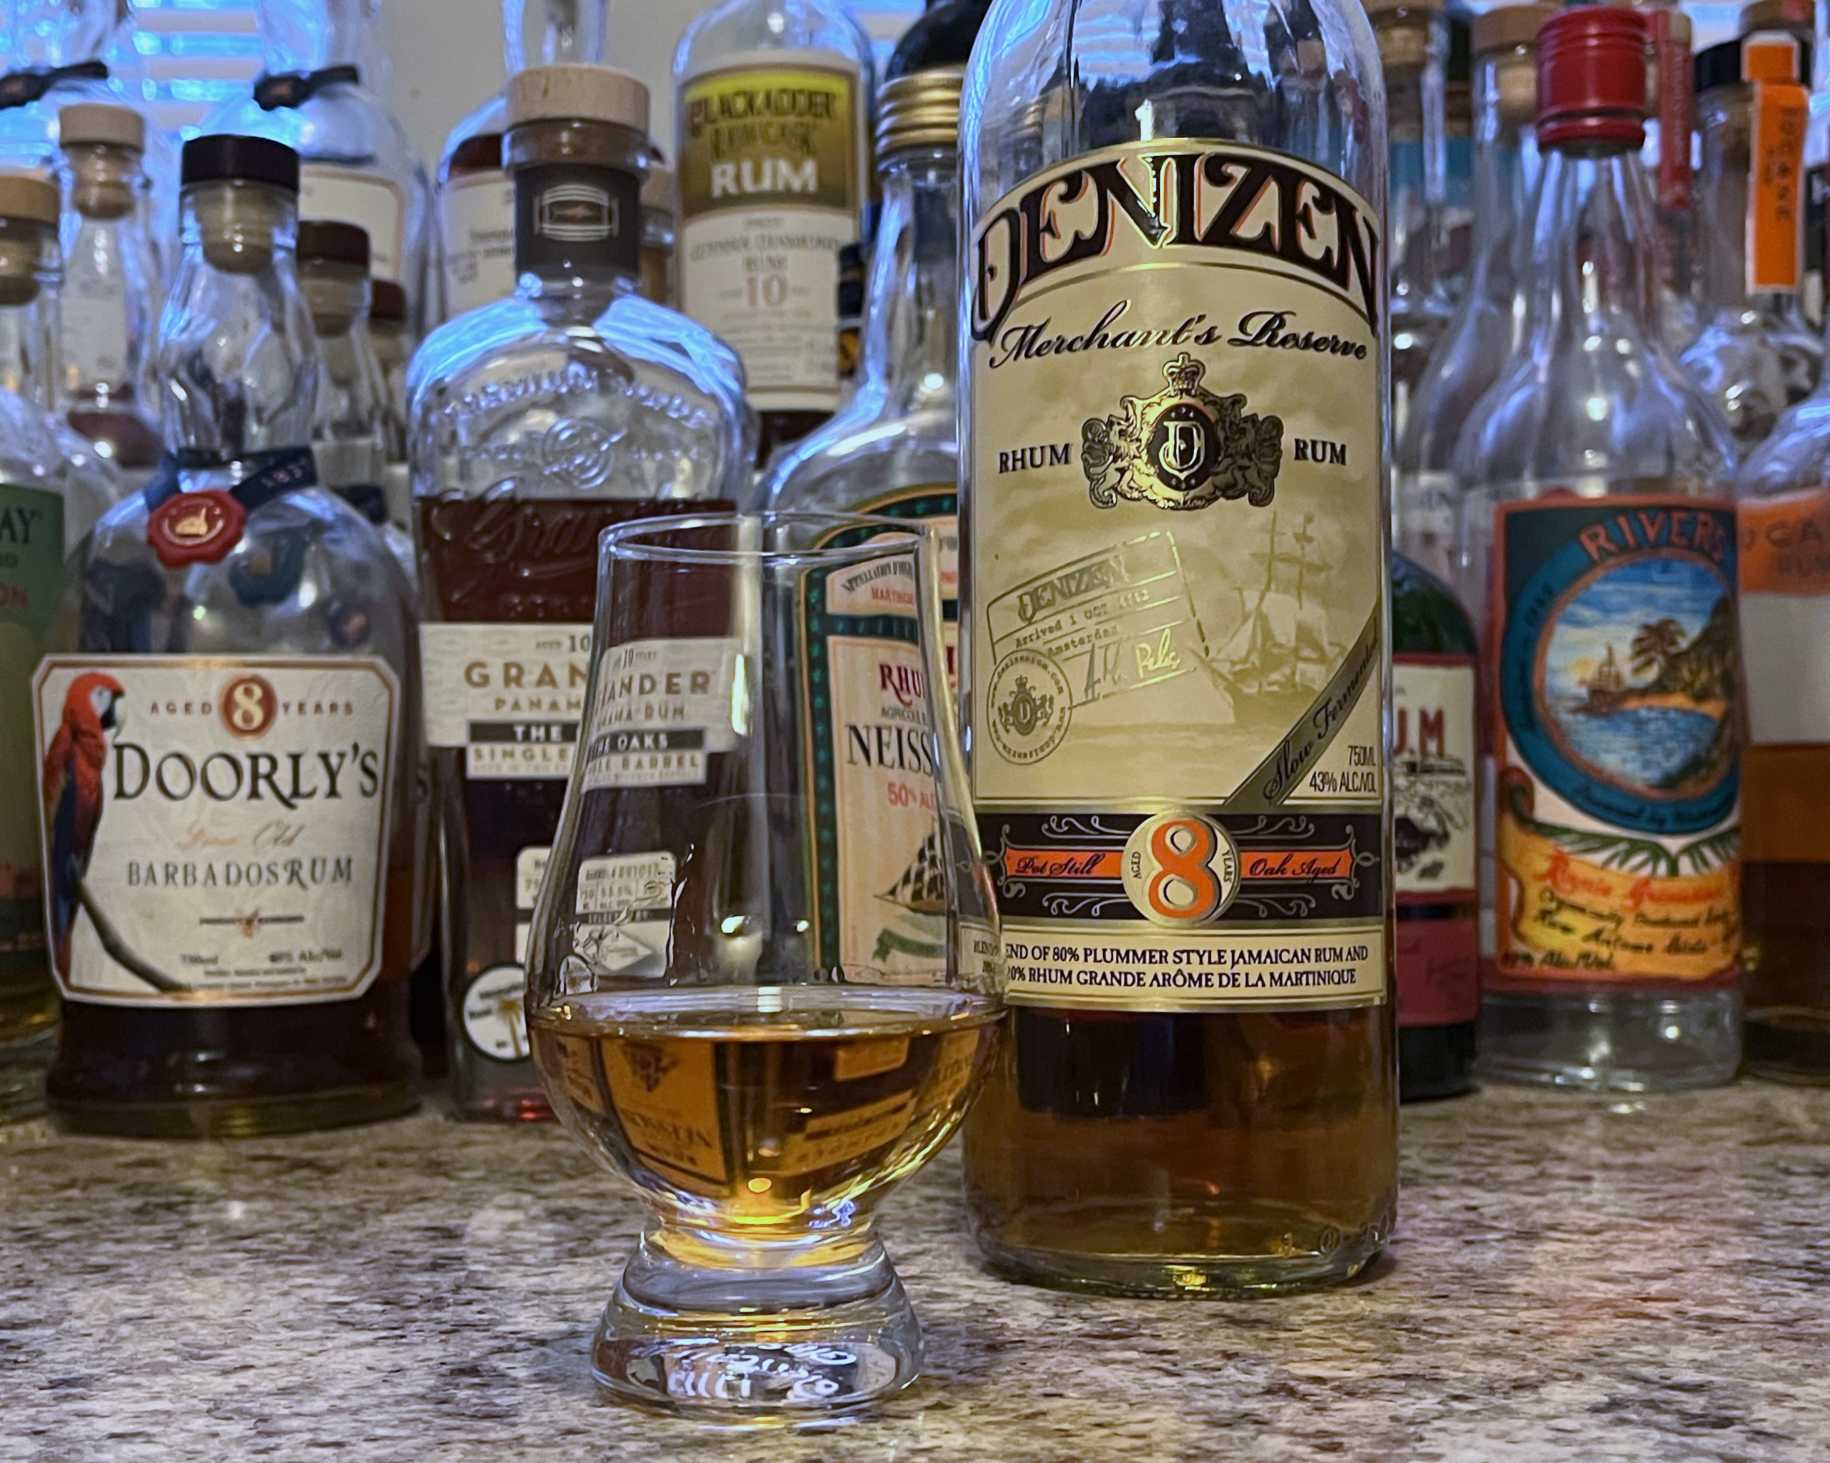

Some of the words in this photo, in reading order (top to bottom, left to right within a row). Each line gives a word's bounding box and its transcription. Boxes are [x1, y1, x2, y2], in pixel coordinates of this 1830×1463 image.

[710, 158, 819, 199] RUM
[971, 150, 1381, 344] DENIZEN
[746, 274, 789, 308] 10
[990, 299, 1220, 368] Merchant's
[1228, 310, 1368, 361] Reserve
[999, 442, 1072, 474] RHUM
[1294, 437, 1347, 466] RUM
[1017, 554, 1130, 623] DENIZEN
[569, 634, 590, 652] 10
[1015, 621, 1062, 649] Arrived
[464, 661, 587, 688] GRAN
[151, 702, 212, 716] AGED
[232, 681, 264, 731] 8
[282, 701, 354, 716] YEARS
[513, 725, 562, 742] THE
[617, 732, 668, 750] OAKS
[845, 724, 934, 777] NEISS
[113, 741, 379, 811] DOORLY'S
[1309, 770, 1338, 792] 43%
[127, 859, 280, 888] BARBADOS
[284, 856, 354, 890] RUM
[1015, 857, 1046, 874] Pot
[1050, 853, 1105, 875] Still
[1131, 851, 1142, 880] AGED
[1148, 817, 1222, 919] 8
[1221, 849, 1234, 883] YEARS
[1249, 854, 1292, 876] Oak
[1292, 857, 1342, 884] Aged
[1031, 945, 1051, 962] OF
[1053, 946, 1080, 963] 80%
[1084, 947, 1169, 965] PLUMMER
[1172, 948, 1227, 966] STYLE
[1231, 948, 1311, 969] JAMAICAN
[1314, 947, 1343, 964] RUM
[1345, 945, 1368, 962] AND
[1028, 968, 1073, 985] RHUM
[1076, 970, 1146, 987] GRANDE
[1149, 967, 1214, 988] ARÔME
[1218, 971, 1241, 988] DE
[1245, 971, 1266, 988] LA
[1269, 968, 1357, 988] MARTINIQUE
